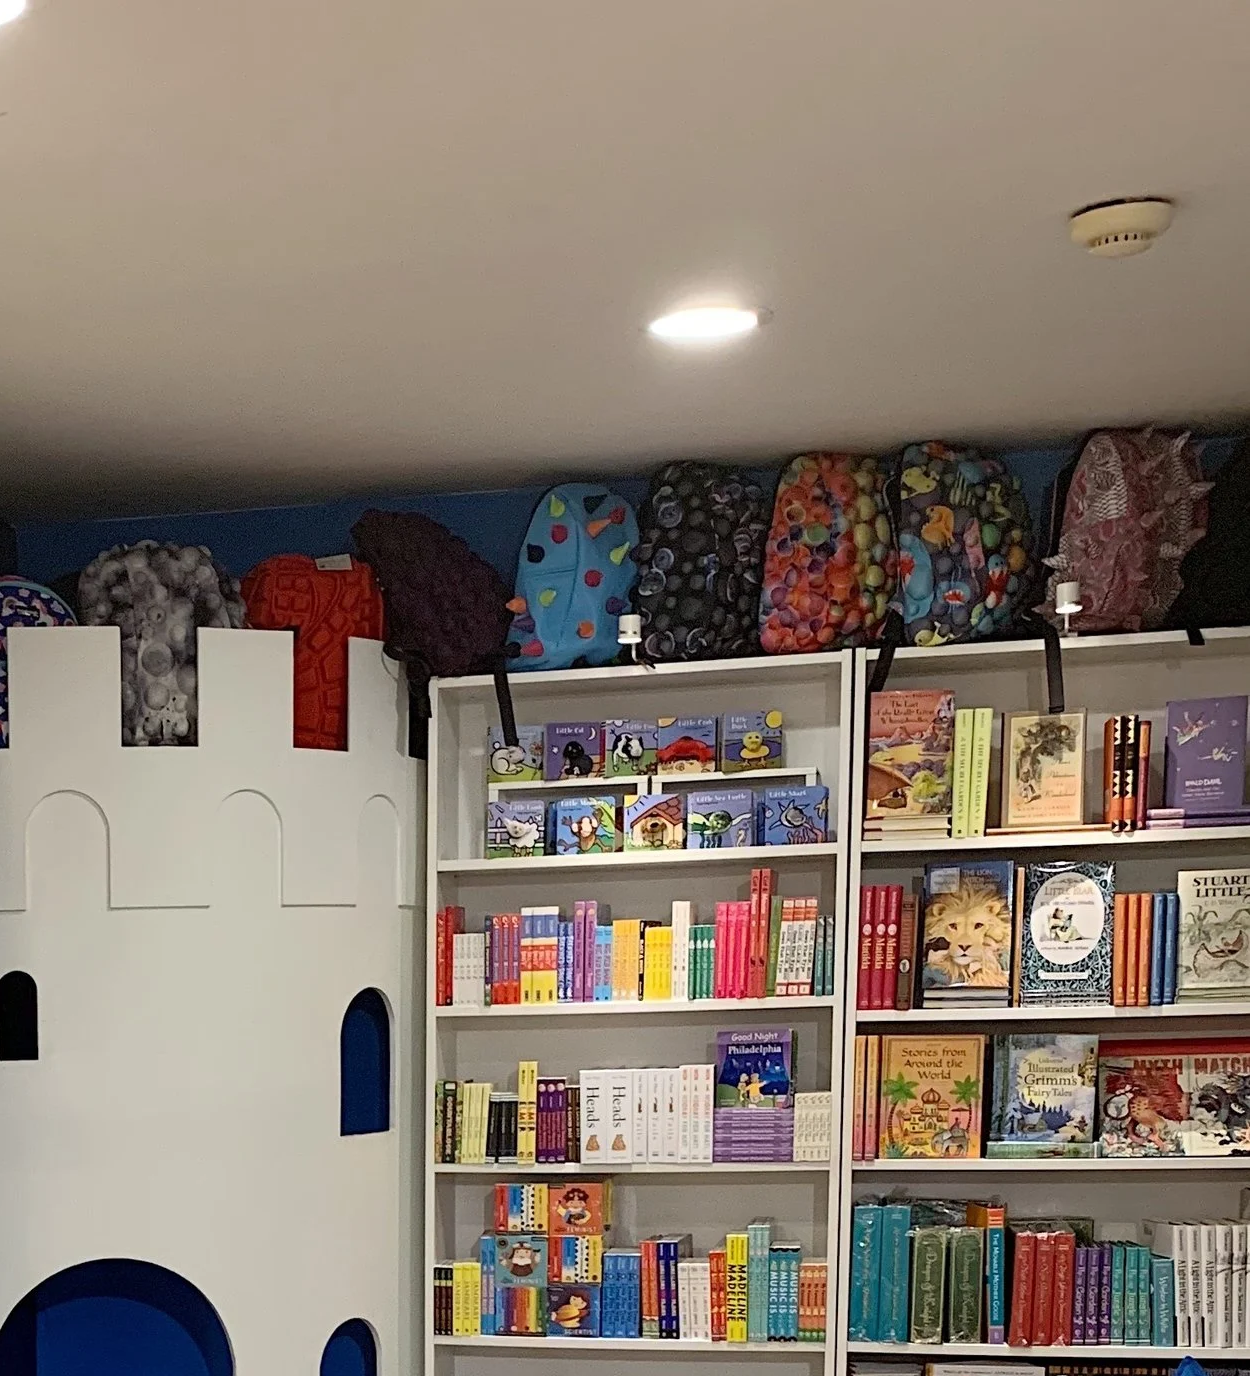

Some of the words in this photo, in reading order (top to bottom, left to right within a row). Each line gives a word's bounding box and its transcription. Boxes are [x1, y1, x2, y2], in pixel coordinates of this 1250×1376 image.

[1192, 875, 1250, 887] STUART
[1196, 886, 1244, 898] LITTLE
[732, 1033, 752, 1042] Good
[754, 1032, 778, 1043] Night
[728, 1043, 783, 1057] Philadelphia
[901, 1047, 938, 1057] Stories
[942, 1045, 967, 1057] from
[904, 1058, 943, 1068] Around
[946, 1058, 963, 1068] the
[1028, 1062, 1075, 1074] Illustrated
[917, 1070, 951, 1080] World
[1024, 1074, 1078, 1087] Grimm's
[1027, 1087, 1050, 1098] Fairy
[1052, 1087, 1072, 1097] Tales
[586, 1087, 599, 1128] Heads
[612, 1086, 625, 1128] Heads
[726, 1264, 736, 1322] MADELINE
[737, 1264, 747, 1322] MADELINE
